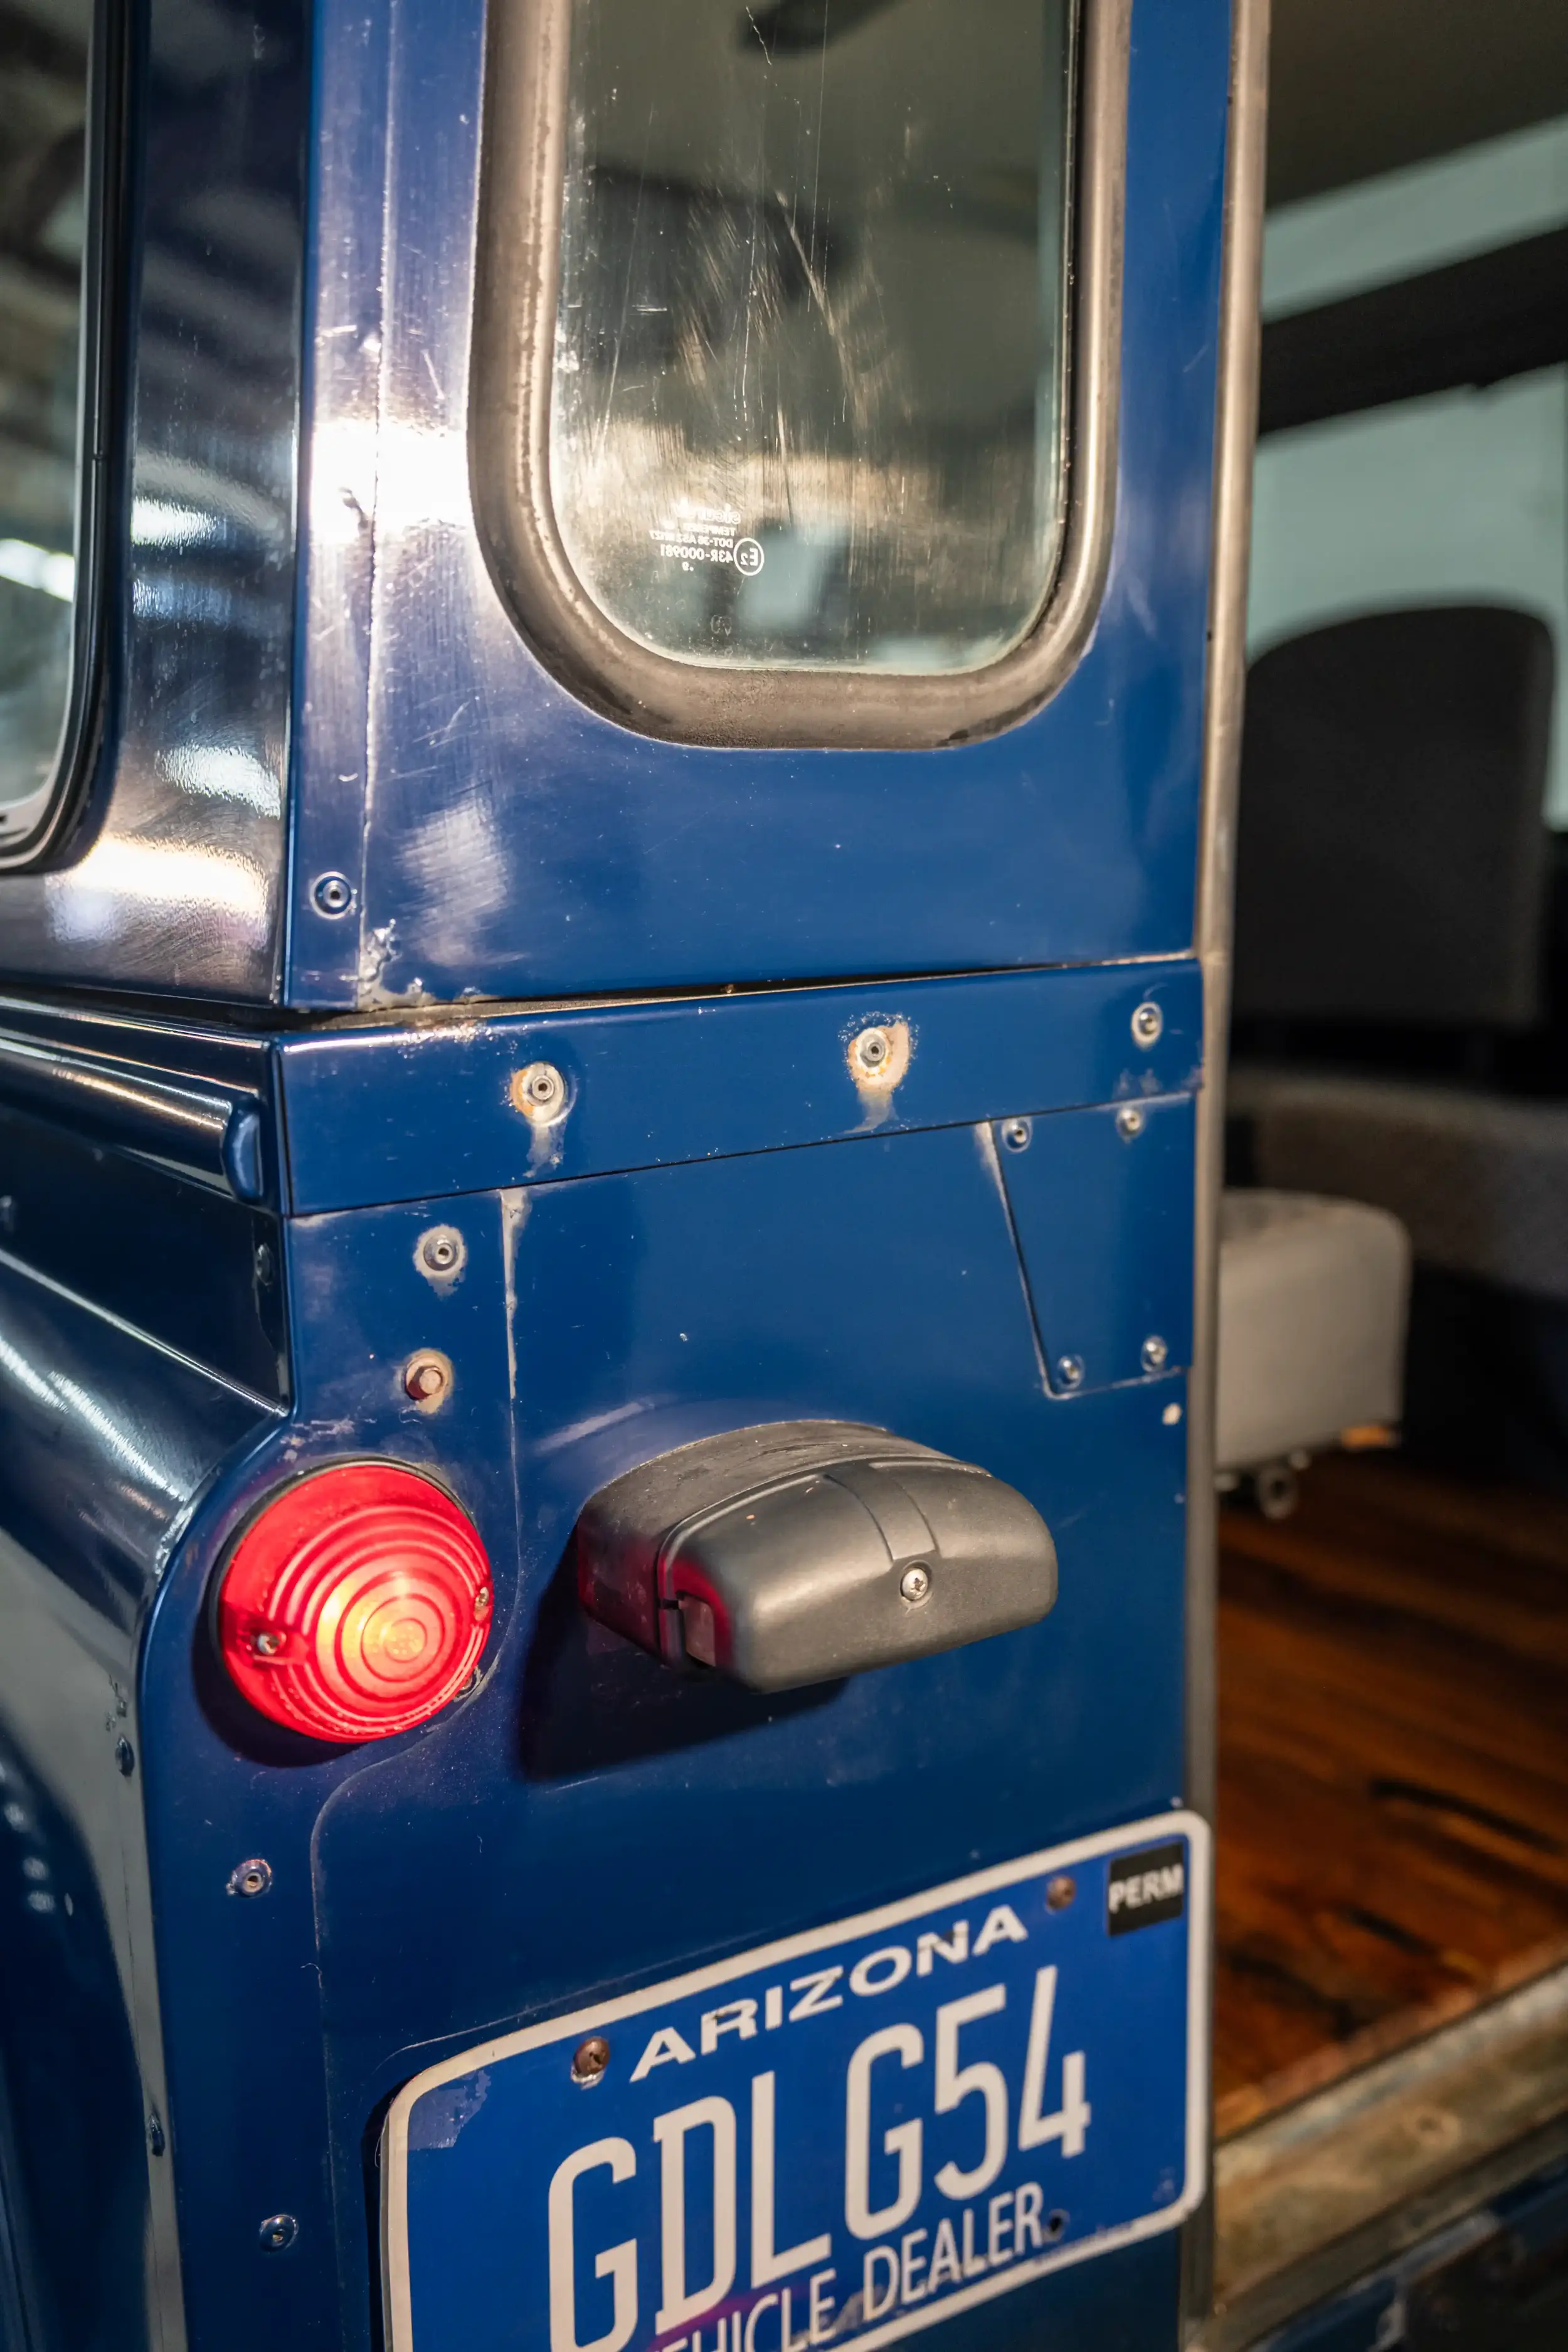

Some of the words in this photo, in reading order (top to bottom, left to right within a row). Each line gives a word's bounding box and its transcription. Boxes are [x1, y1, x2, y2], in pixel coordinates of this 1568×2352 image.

[1108, 1863, 1184, 1914] PERM
[629, 1904, 1028, 2082] ARIZONA
[863, 2181, 1043, 2321] DEALER
